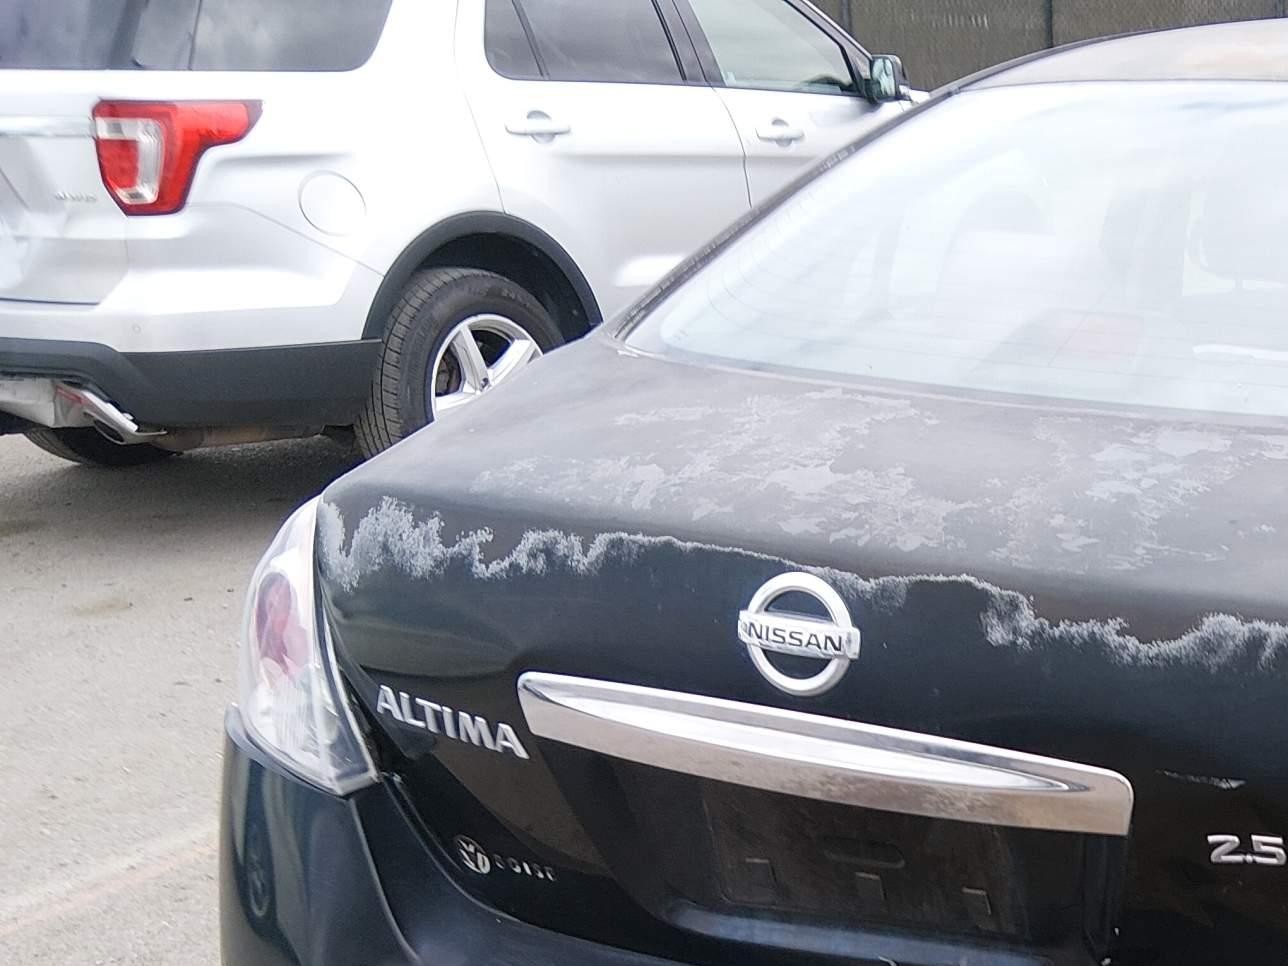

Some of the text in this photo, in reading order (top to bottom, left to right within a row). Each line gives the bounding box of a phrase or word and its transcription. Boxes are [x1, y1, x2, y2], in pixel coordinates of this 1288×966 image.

[748, 620, 843, 652] NISSAN
[376, 684, 531, 760] ALTIMA
[1207, 834, 1287, 866] 2.5
